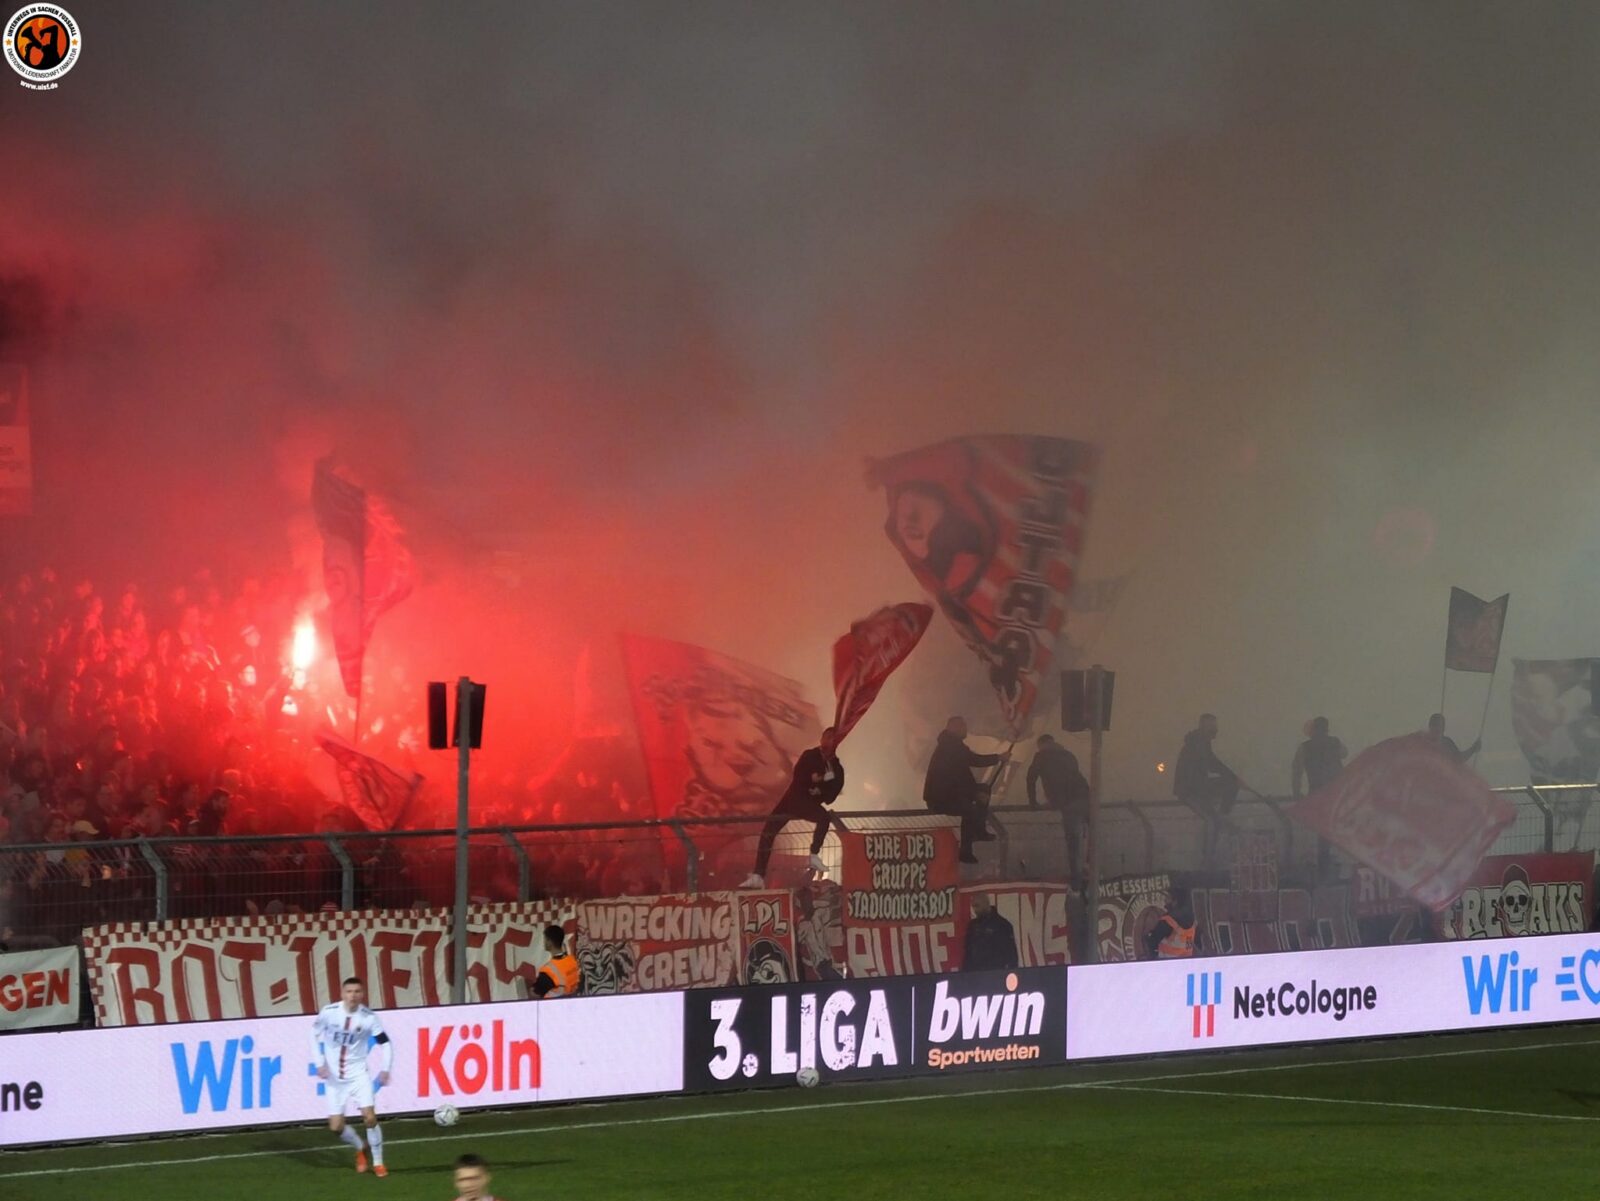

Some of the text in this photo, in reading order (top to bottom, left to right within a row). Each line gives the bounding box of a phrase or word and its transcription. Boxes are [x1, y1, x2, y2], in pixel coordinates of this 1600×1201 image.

[866, 833, 934, 860] EHRE DER
[872, 860, 927, 889] GRUPPE
[585, 903, 731, 942] WRECKING
[742, 898, 789, 935] LPL
[637, 944, 716, 991] CREW
[1462, 950, 1539, 1016] Wir
[928, 972, 1046, 1043] bwin
[1233, 979, 1378, 1021] NetCologne
[707, 990, 899, 1081] 3. LIGA
[927, 1043, 1040, 1070] Sportwetten
[170, 1035, 282, 1114] Wir
[416, 1018, 542, 1099] Köln
